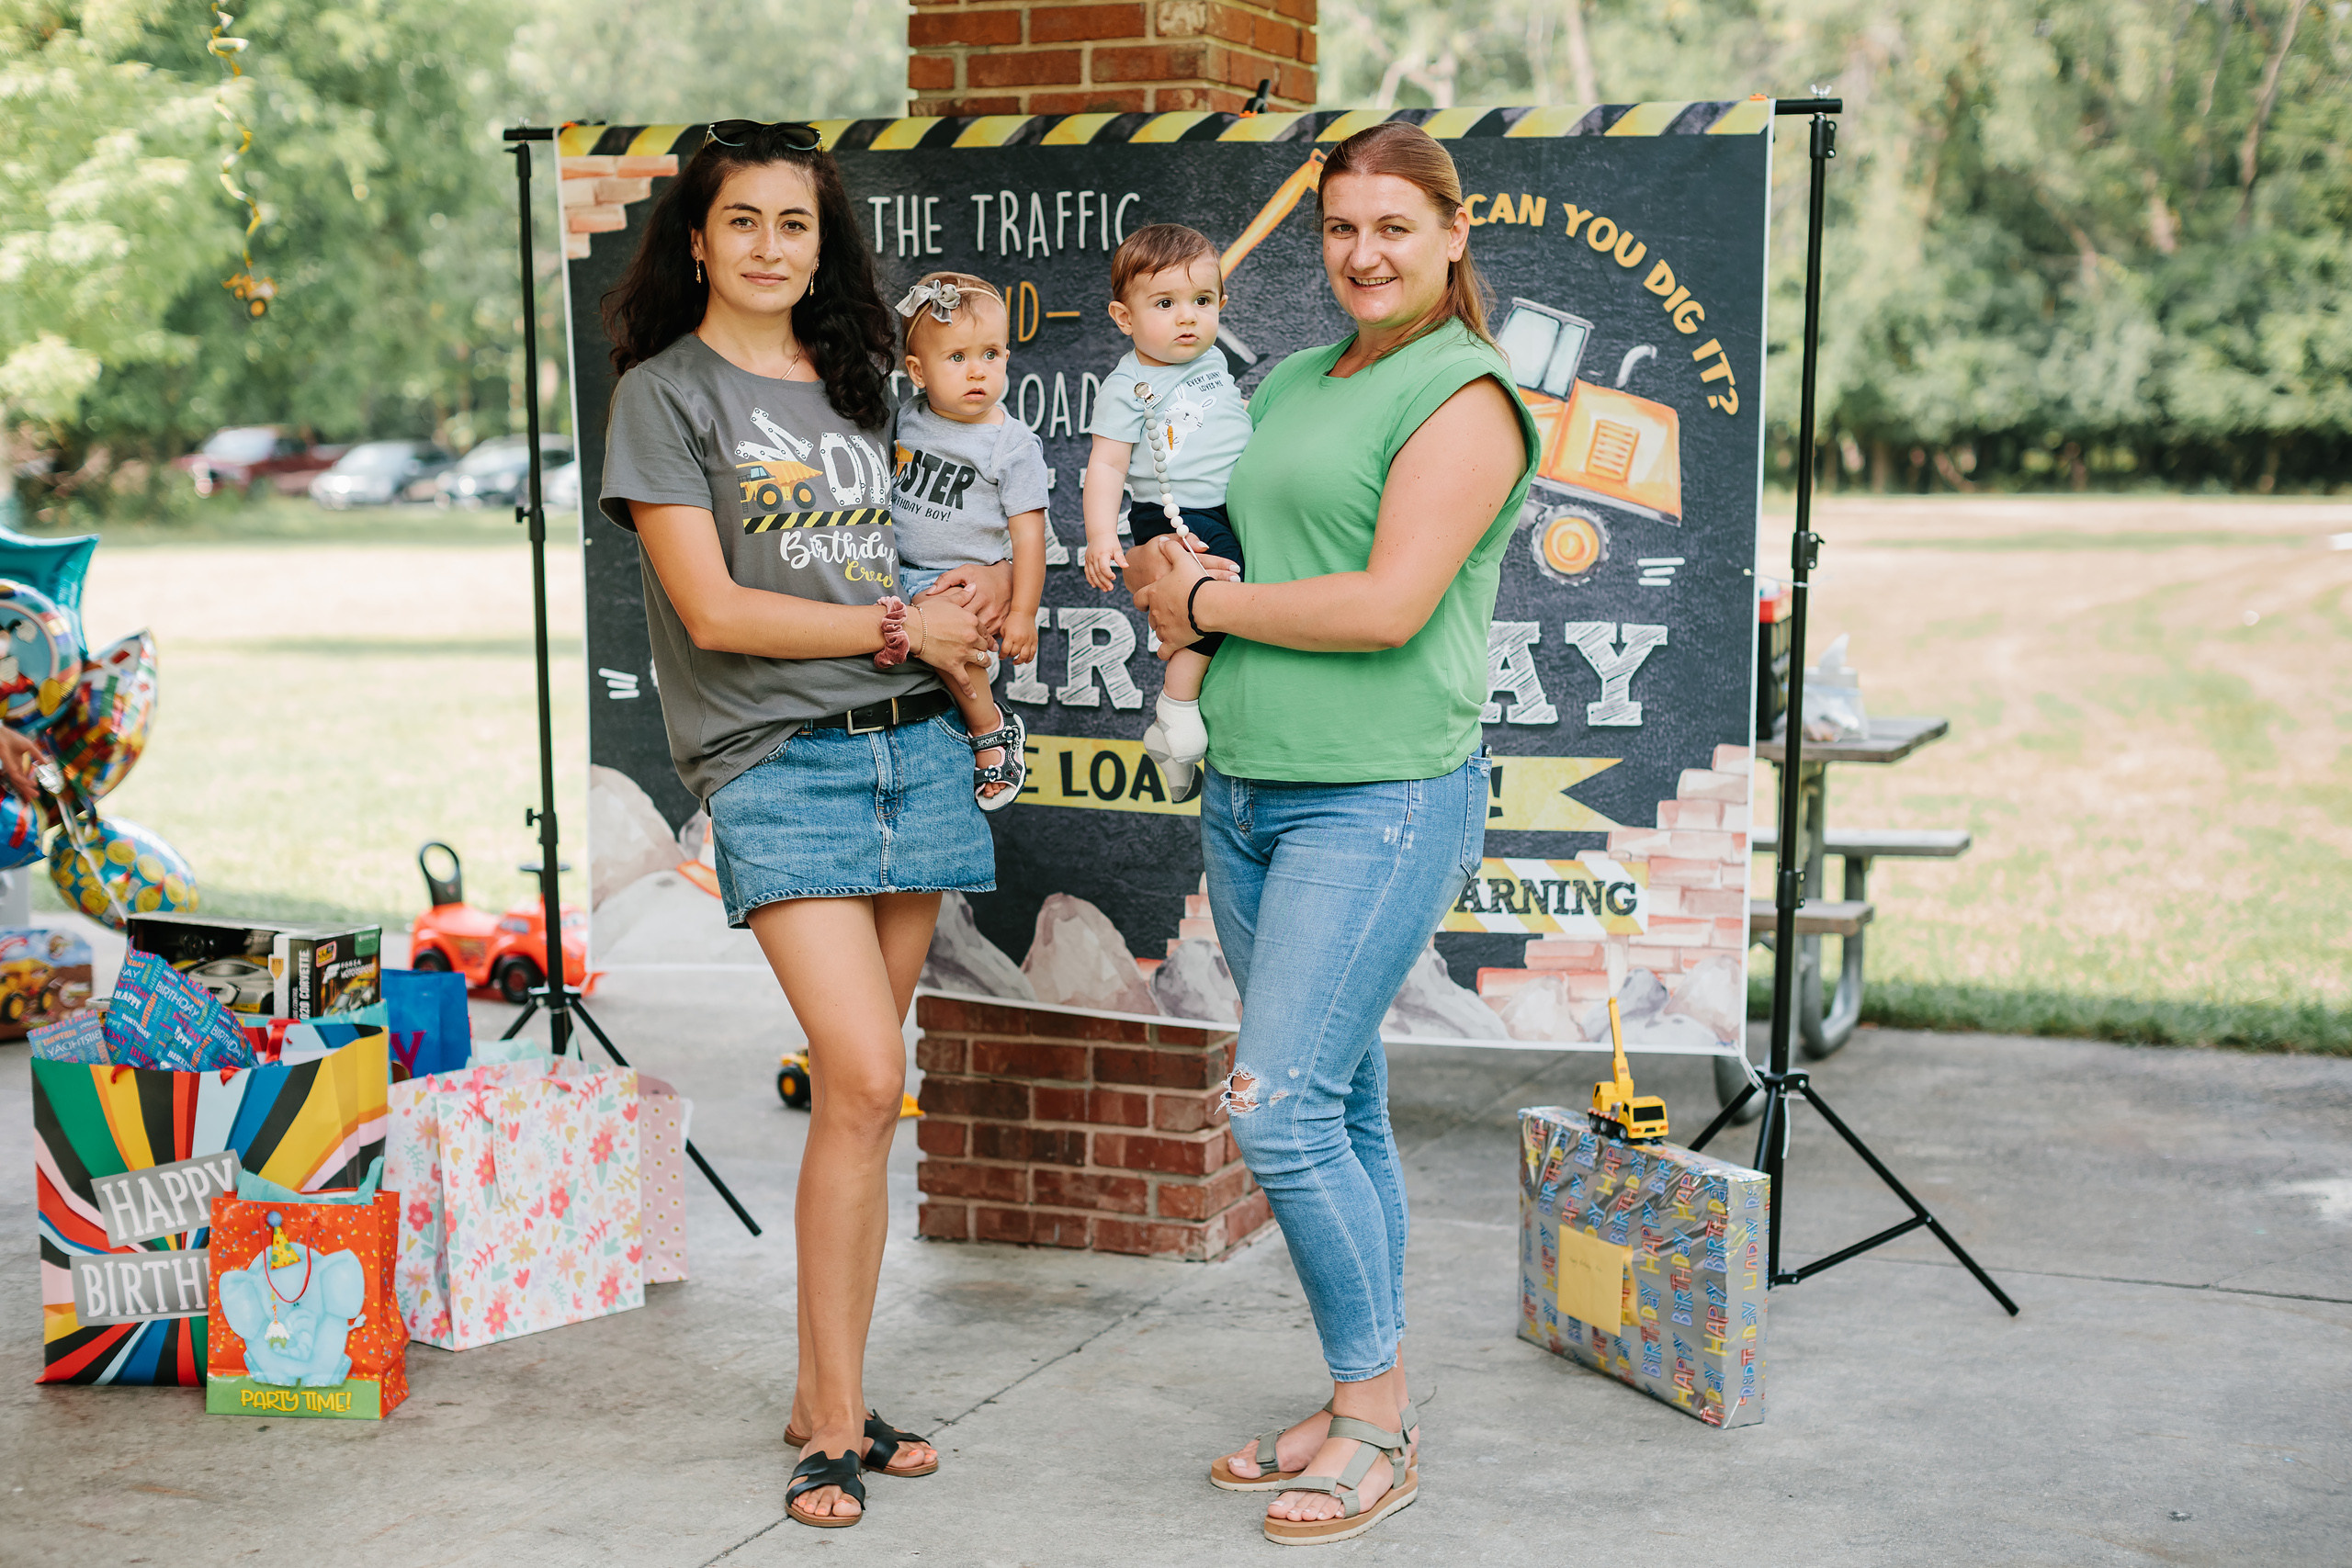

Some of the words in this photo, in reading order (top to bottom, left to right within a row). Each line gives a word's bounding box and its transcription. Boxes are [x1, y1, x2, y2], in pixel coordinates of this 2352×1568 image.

[867, 195, 944, 258] THE
[971, 189, 1141, 259] TRAFFIC
[1464, 194, 1547, 227] CAN
[1563, 202, 1647, 268] YOU
[1643, 259, 1706, 334] DIG
[1691, 338, 1740, 417] IT?
[1186, 375, 1205, 388] EVERY
[1199, 382, 1216, 393] LOVES
[999, 370, 1102, 439] OAD
[821, 432, 892, 513] ON
[900, 449, 976, 510] STER
[891, 494, 922, 514] RTHDAY
[925, 508, 952, 523] BOY!
[780, 531, 897, 573] Birthday
[844, 558, 895, 588] Crew
[977, 736, 999, 748] SPORT
[1454, 877, 1637, 917] ARNING
[299, 948, 311, 1000] CORVETTE
[114, 990, 141, 1010] HAPPY
[155, 980, 200, 1017] BIRTHDAY
[107, 1018, 122, 1030] PPY
[121, 1013, 152, 1039] BIRTHDAY
[210, 1024, 244, 1060] BIRTHDAY
[101, 1157, 233, 1240] HAPPY
[1562, 1172, 1587, 1228] APPY
[1639, 1200, 1664, 1275] HAPPY
[80, 1257, 209, 1317] BIRTH
[1703, 1279, 1729, 1357] HAPPY
[1671, 1332, 1696, 1409] HAPPY
[240, 1389, 300, 1412] PARTY
[300, 1391, 352, 1413] TIME!
